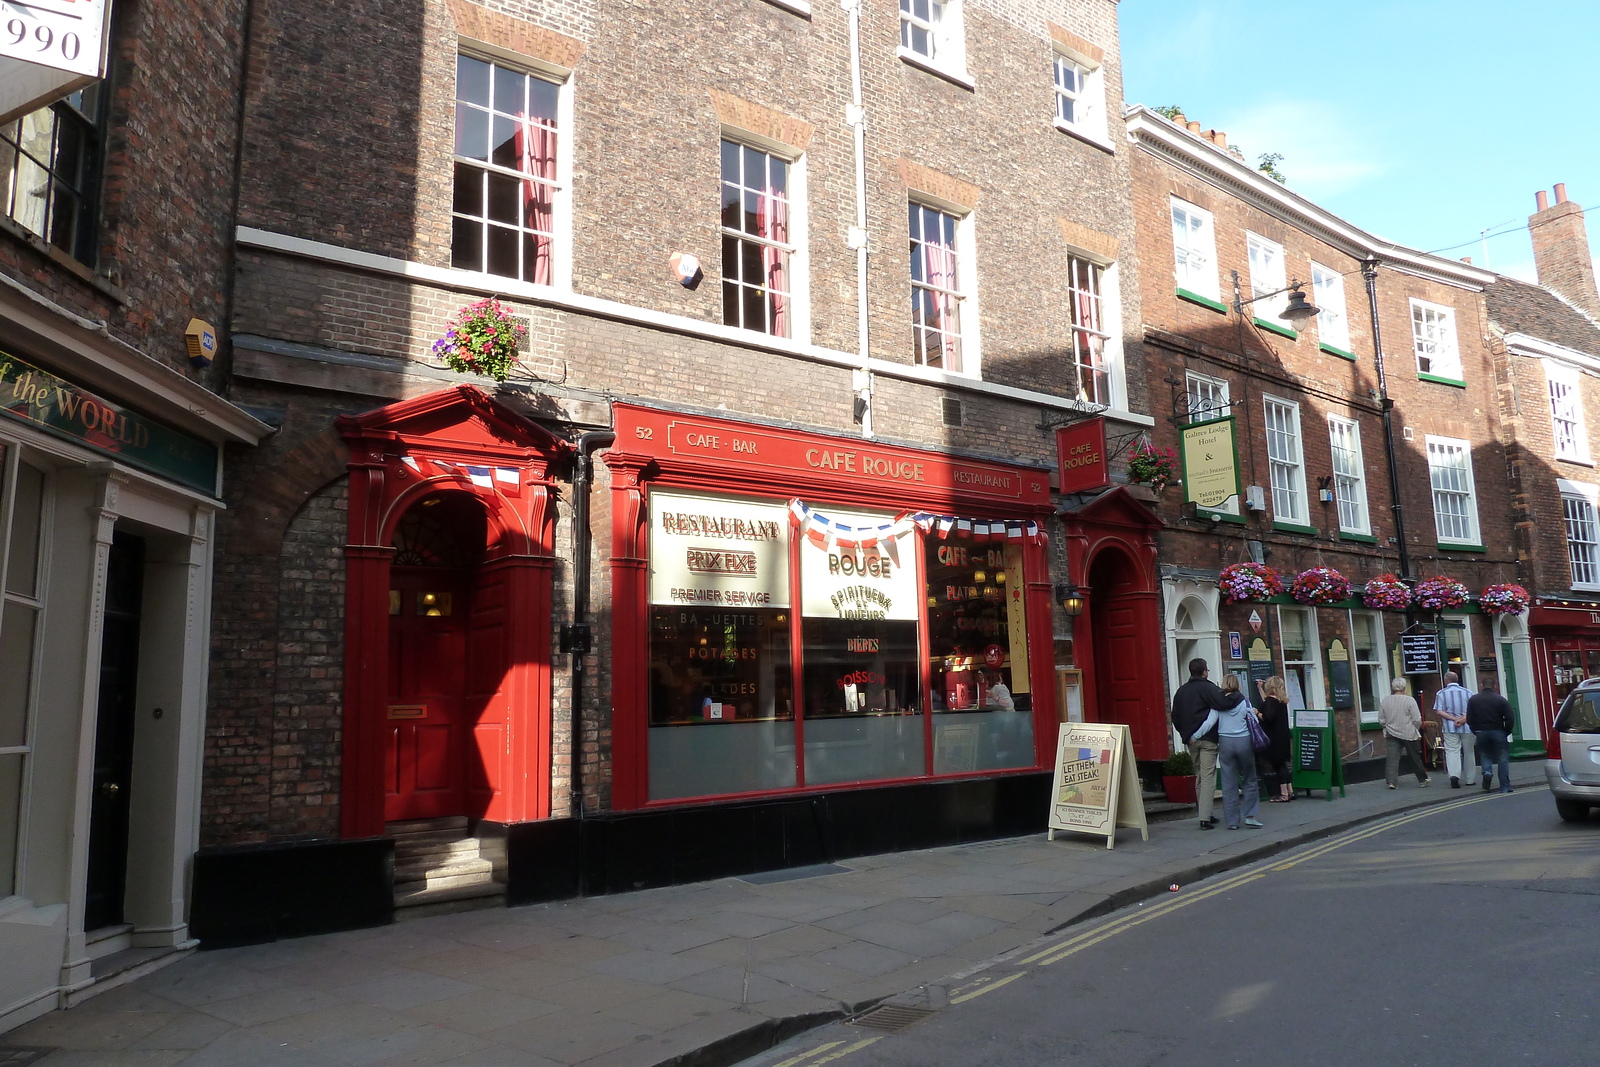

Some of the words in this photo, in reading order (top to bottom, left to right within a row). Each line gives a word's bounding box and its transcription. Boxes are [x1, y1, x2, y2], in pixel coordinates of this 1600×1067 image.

[12, 372, 48, 408] the
[54, 385, 150, 449] WORLD
[635, 426, 653, 440] 52
[1185, 431, 1207, 439] Galtres
[1208, 426, 1229, 434] Lodge
[733, 438, 759, 455] BAR
[1198, 436, 1217, 445] Hotel
[1064, 452, 1100, 470] ROUGE
[1205, 453, 1213, 461] &
[862, 455, 925, 482] ROUGE
[953, 470, 1011, 489] RESTAURANT
[1030, 482, 1042, 493] 52
[662, 511, 780, 541] RESTAURANT
[687, 550, 721, 569] PRIX
[725, 552, 757, 572] FIXE
[828, 553, 892, 578] ROUGE
[671, 587, 722, 603] PREMIER
[724, 590, 771, 605] SERVICE
[680, 612, 763, 626] BAUETTES
[839, 609, 885, 620] LIQUEURS
[689, 647, 757, 660] POTAGES
[1087, 735, 1110, 743] ROUGE
[1063, 764, 1075, 774] LET
[1076, 761, 1095, 771] THEM
[1064, 774, 1076, 783] EAT
[1077, 769, 1099, 780] STEAK!
